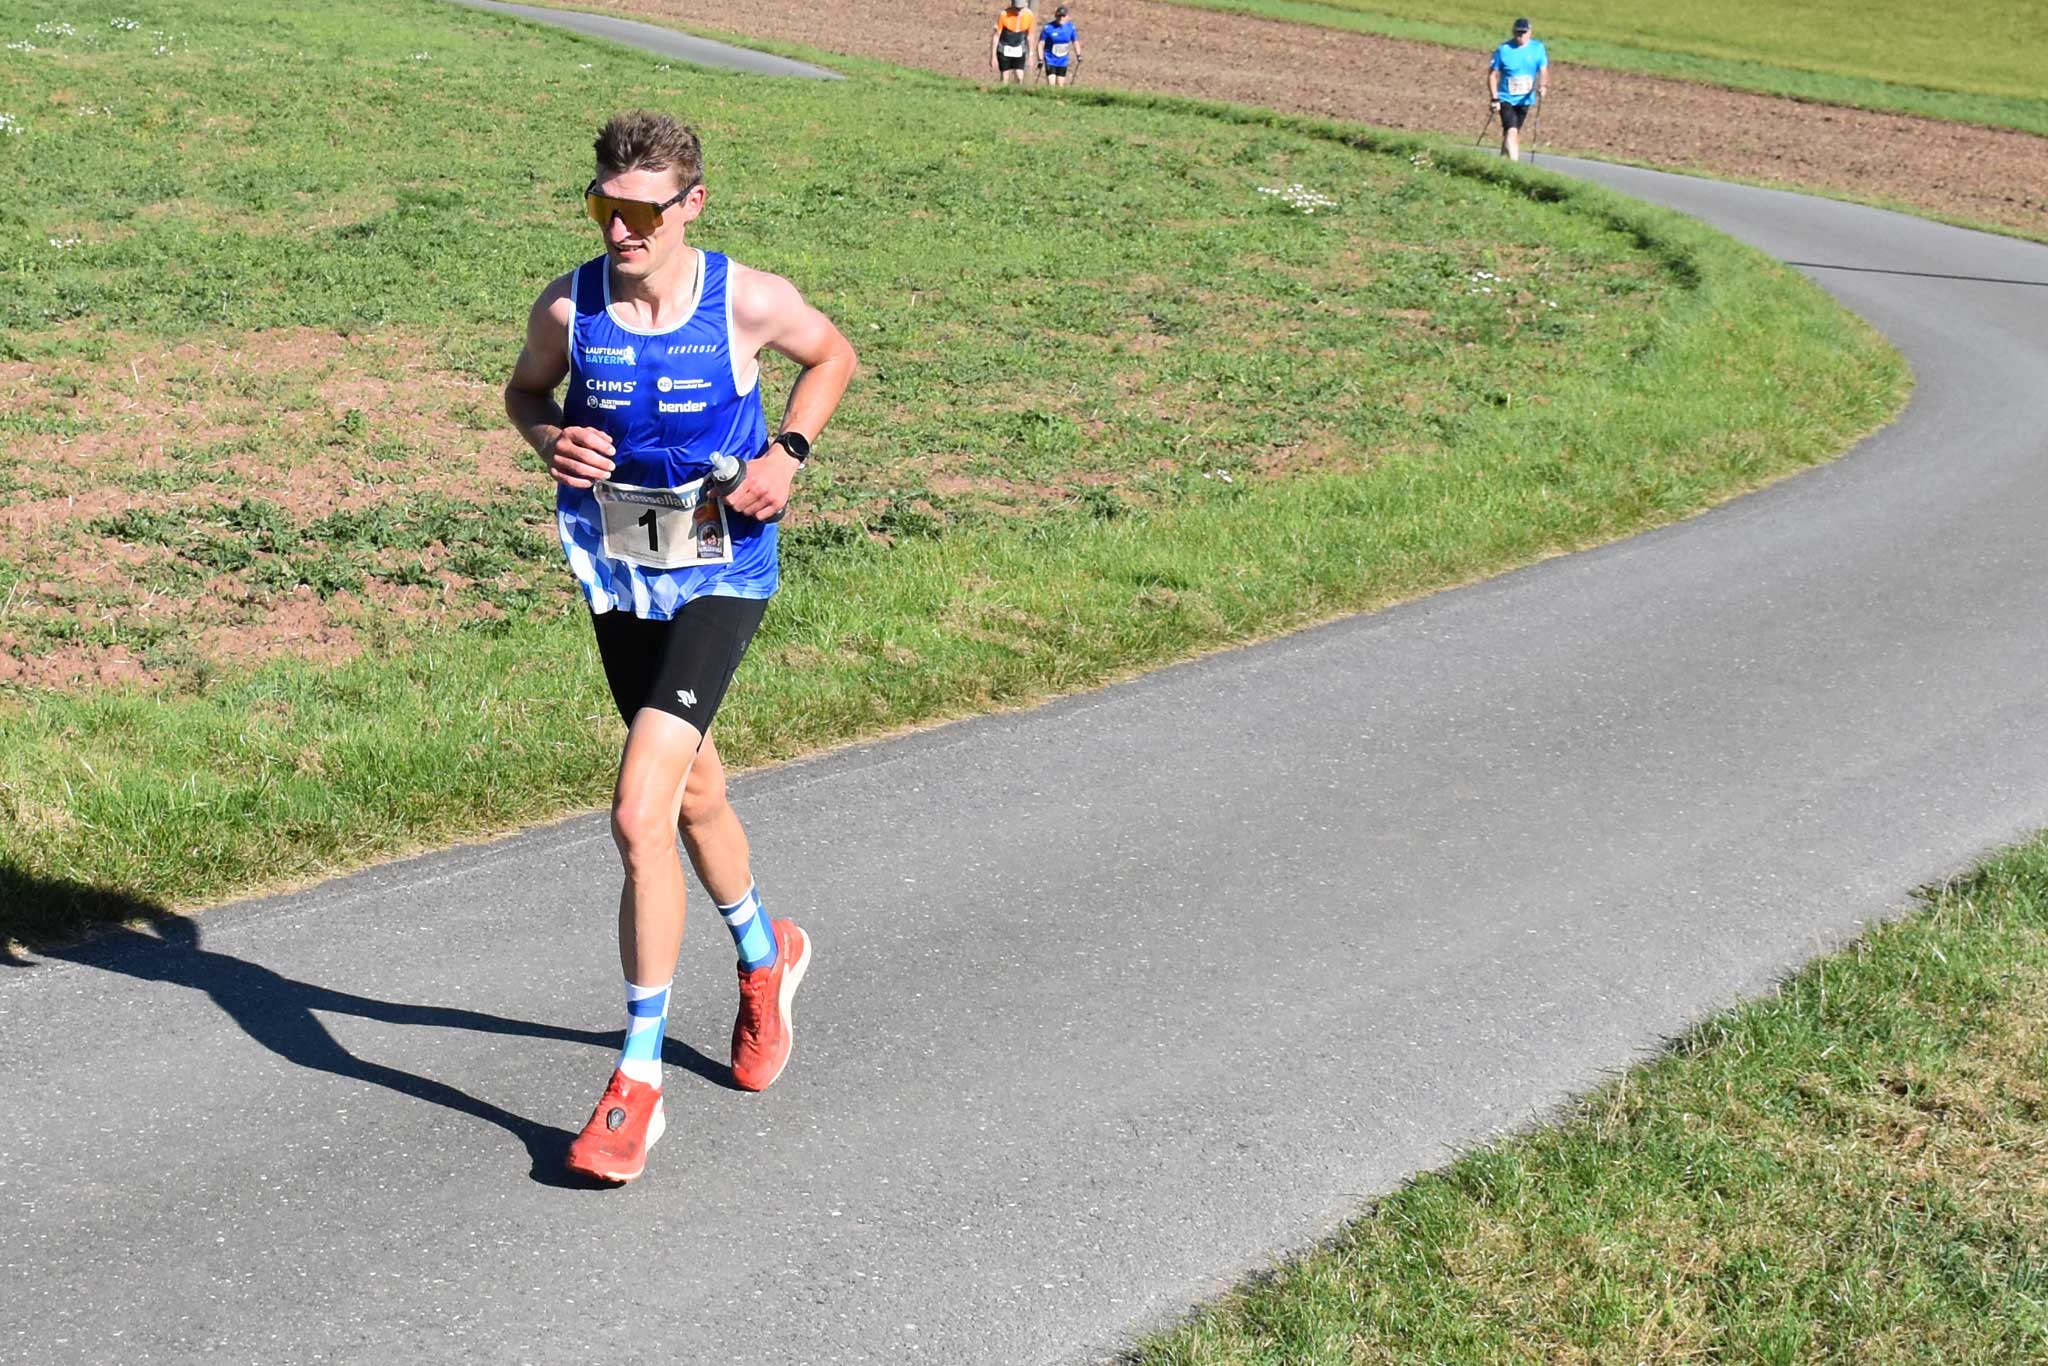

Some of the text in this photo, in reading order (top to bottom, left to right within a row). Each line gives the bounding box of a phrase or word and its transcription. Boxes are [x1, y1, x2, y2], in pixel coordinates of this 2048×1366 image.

[585, 346, 624, 356] LAUFTEAM
[585, 354, 625, 365] BAYERN
[586, 378, 634, 393] CHMS
[658, 399, 707, 413] bender
[620, 492, 697, 509] Kessellauf
[638, 508, 658, 552] 1
